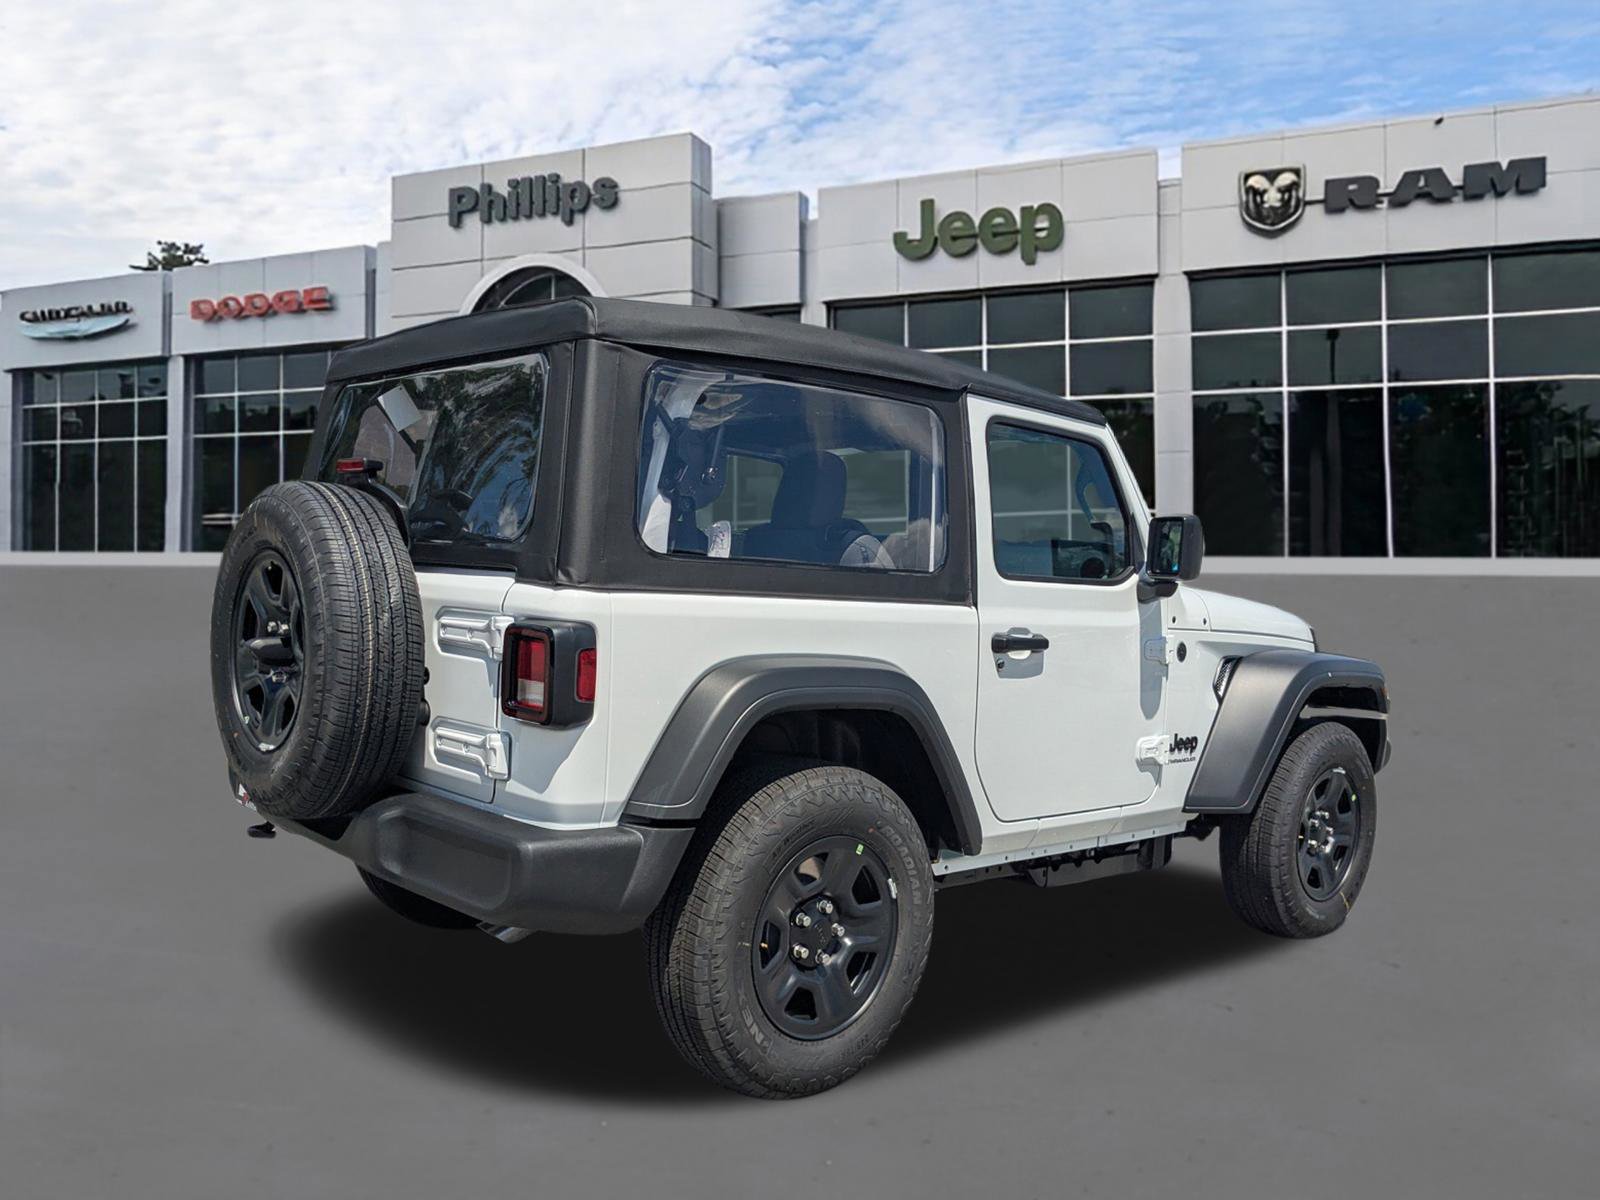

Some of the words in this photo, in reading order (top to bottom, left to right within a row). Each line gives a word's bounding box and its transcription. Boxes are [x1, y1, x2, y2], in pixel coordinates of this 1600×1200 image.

[448, 172, 620, 228] Phillips
[1324, 156, 1547, 214] RAM
[893, 198, 1064, 266] Jeep
[190, 286, 332, 322] DODGE
[1169, 733, 1198, 754] Jeep
